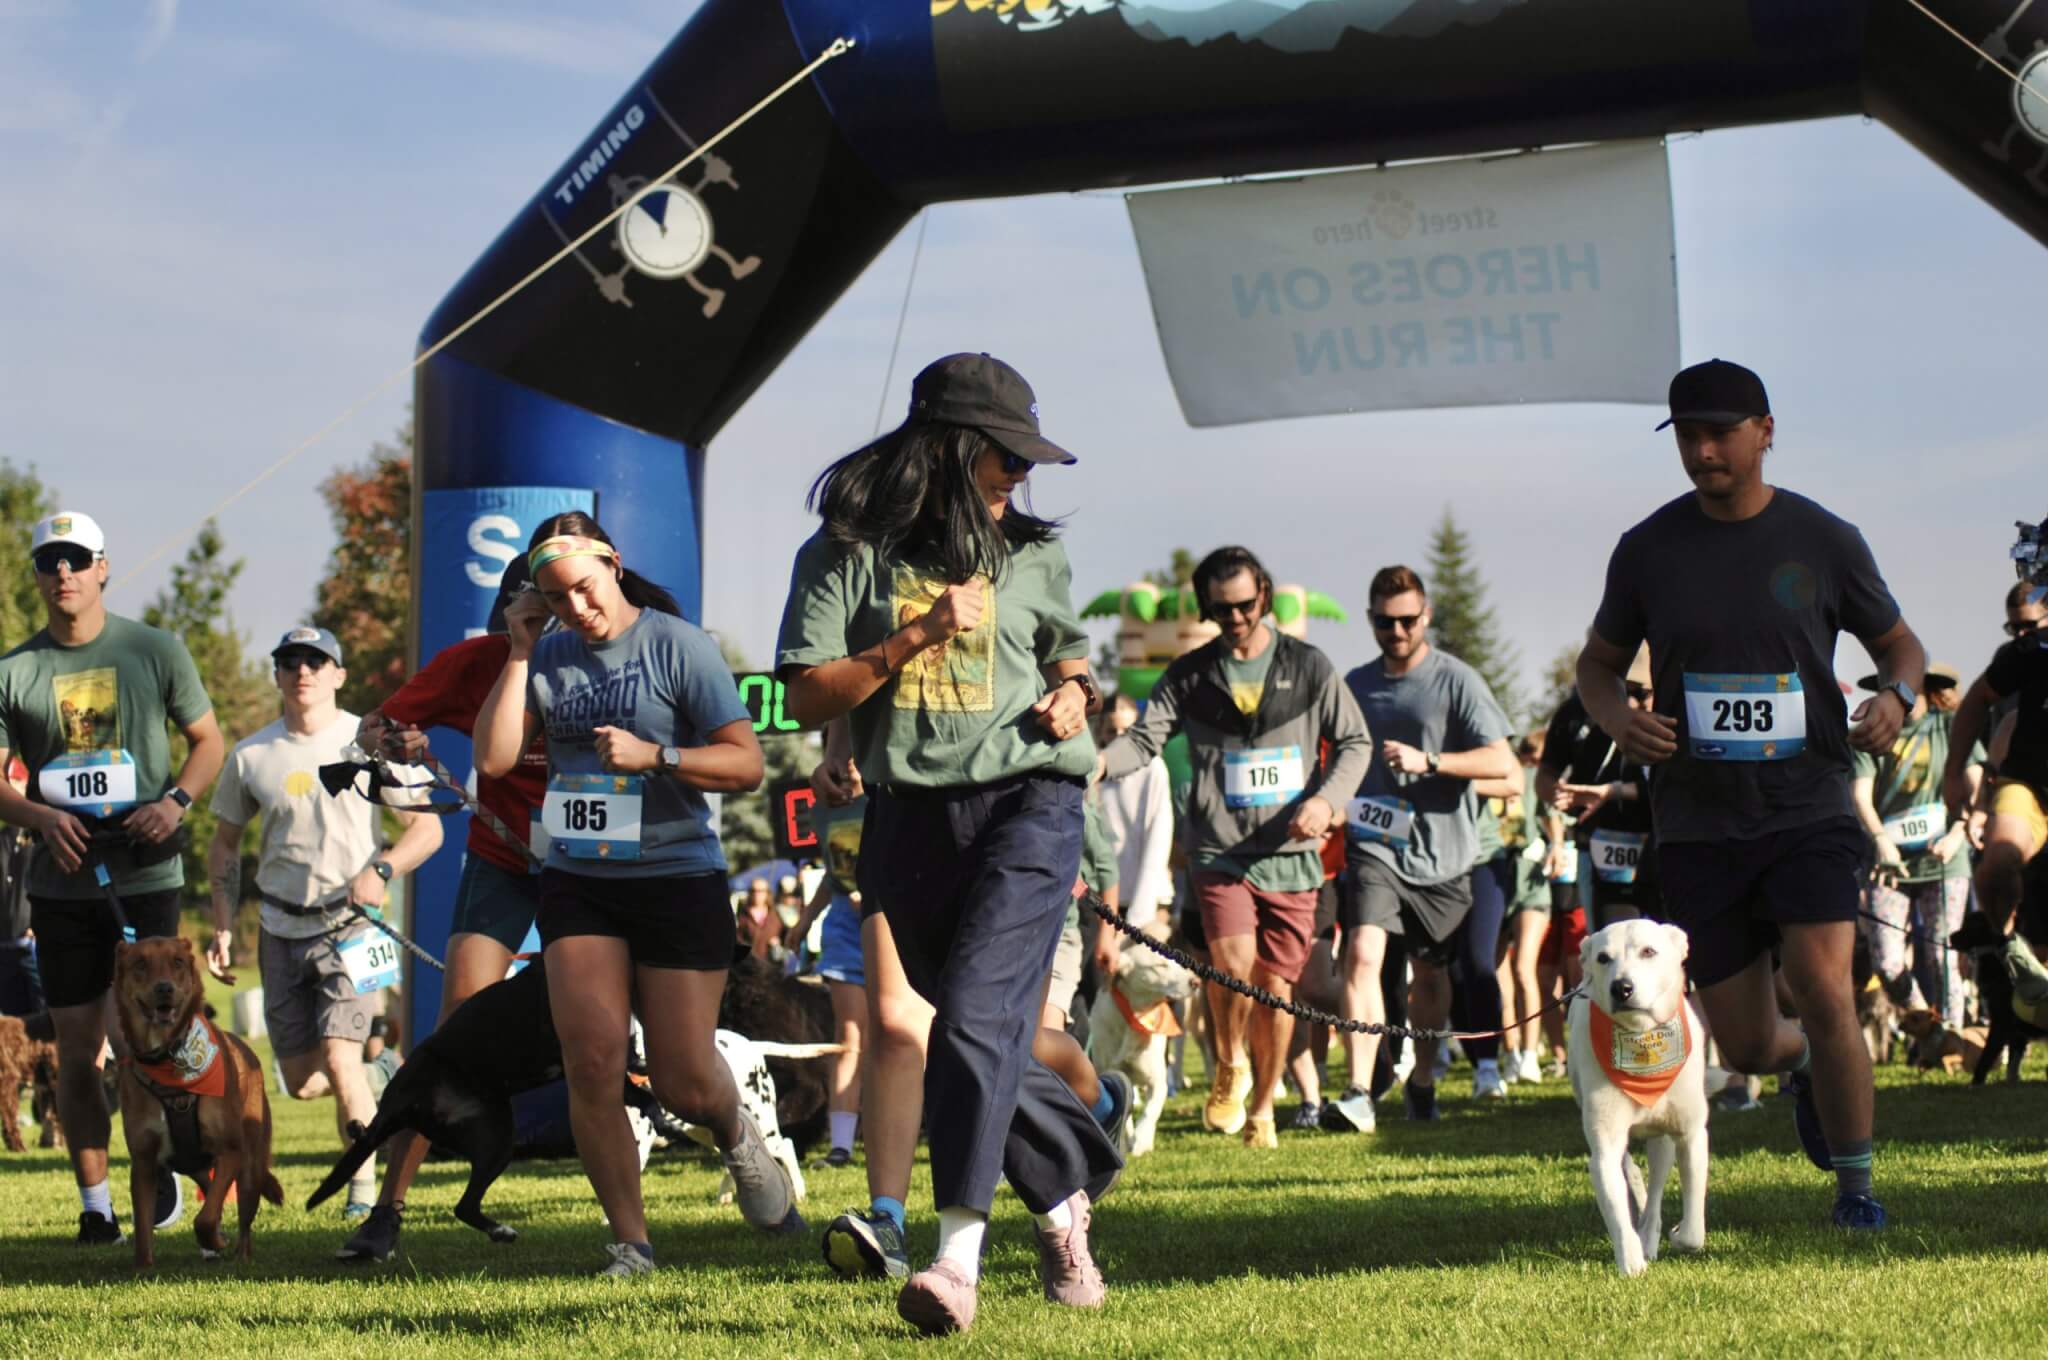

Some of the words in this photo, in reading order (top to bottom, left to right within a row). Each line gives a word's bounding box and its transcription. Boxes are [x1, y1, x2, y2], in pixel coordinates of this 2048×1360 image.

[554, 104, 645, 204] TIMING
[1713, 699, 1773, 732] 293
[66, 771, 108, 798] 108
[1248, 766, 1279, 787] 176
[562, 799, 607, 831] 185
[1359, 803, 1393, 830] 320
[1901, 820, 1928, 838] 109
[1604, 845, 1638, 867] 260
[367, 942, 393, 968] 314
